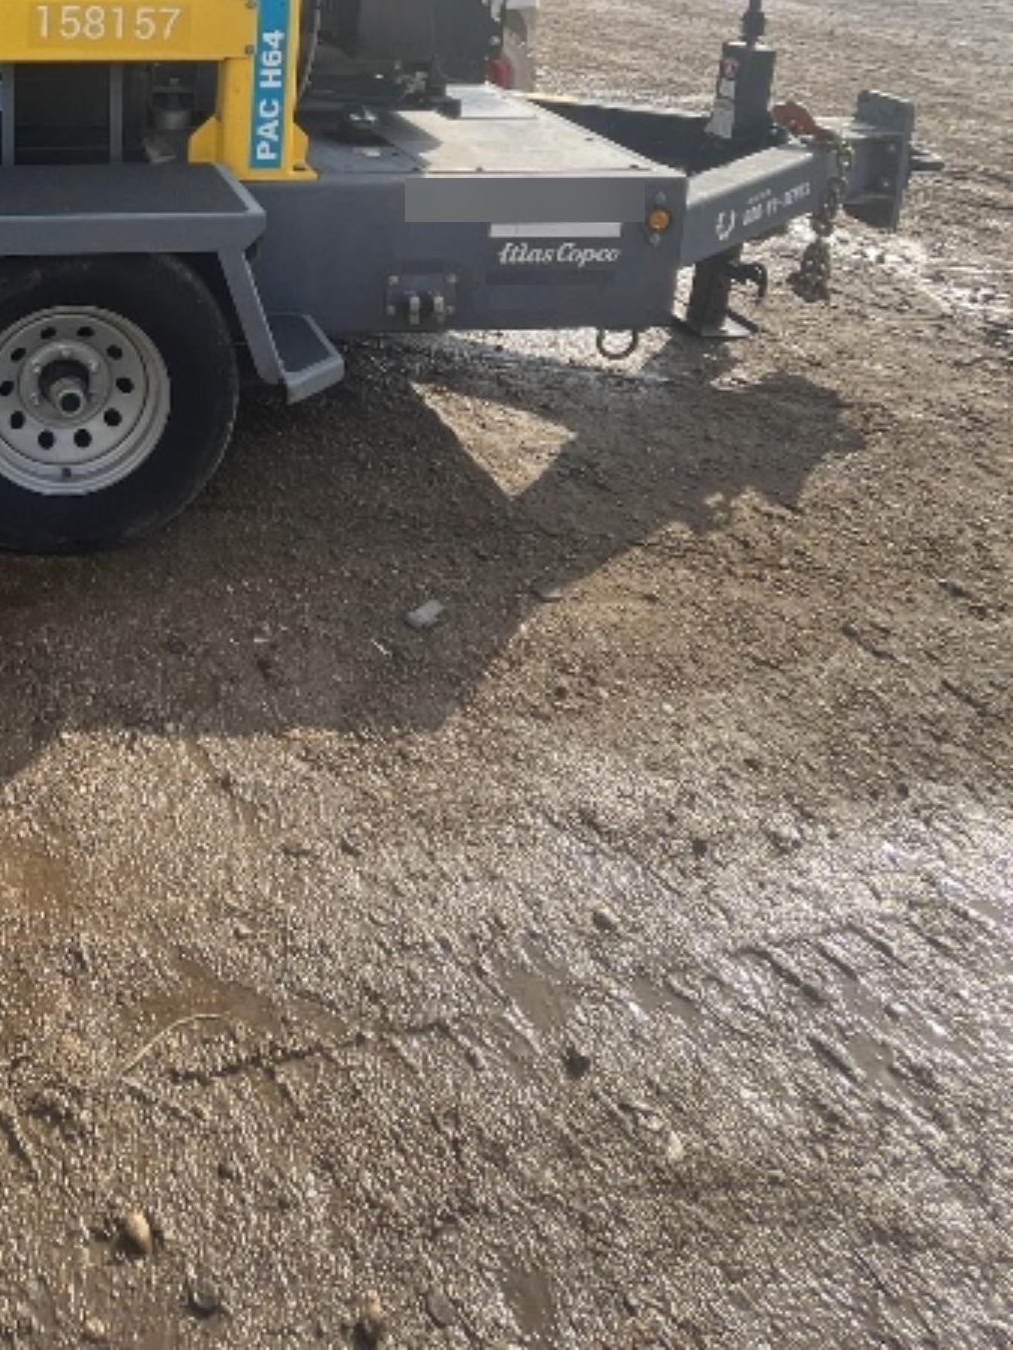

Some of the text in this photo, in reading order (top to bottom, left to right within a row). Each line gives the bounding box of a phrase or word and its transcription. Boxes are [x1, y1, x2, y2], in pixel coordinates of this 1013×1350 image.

[36, 4, 181, 41] 158157
[256, 30, 285, 161] PAC H64
